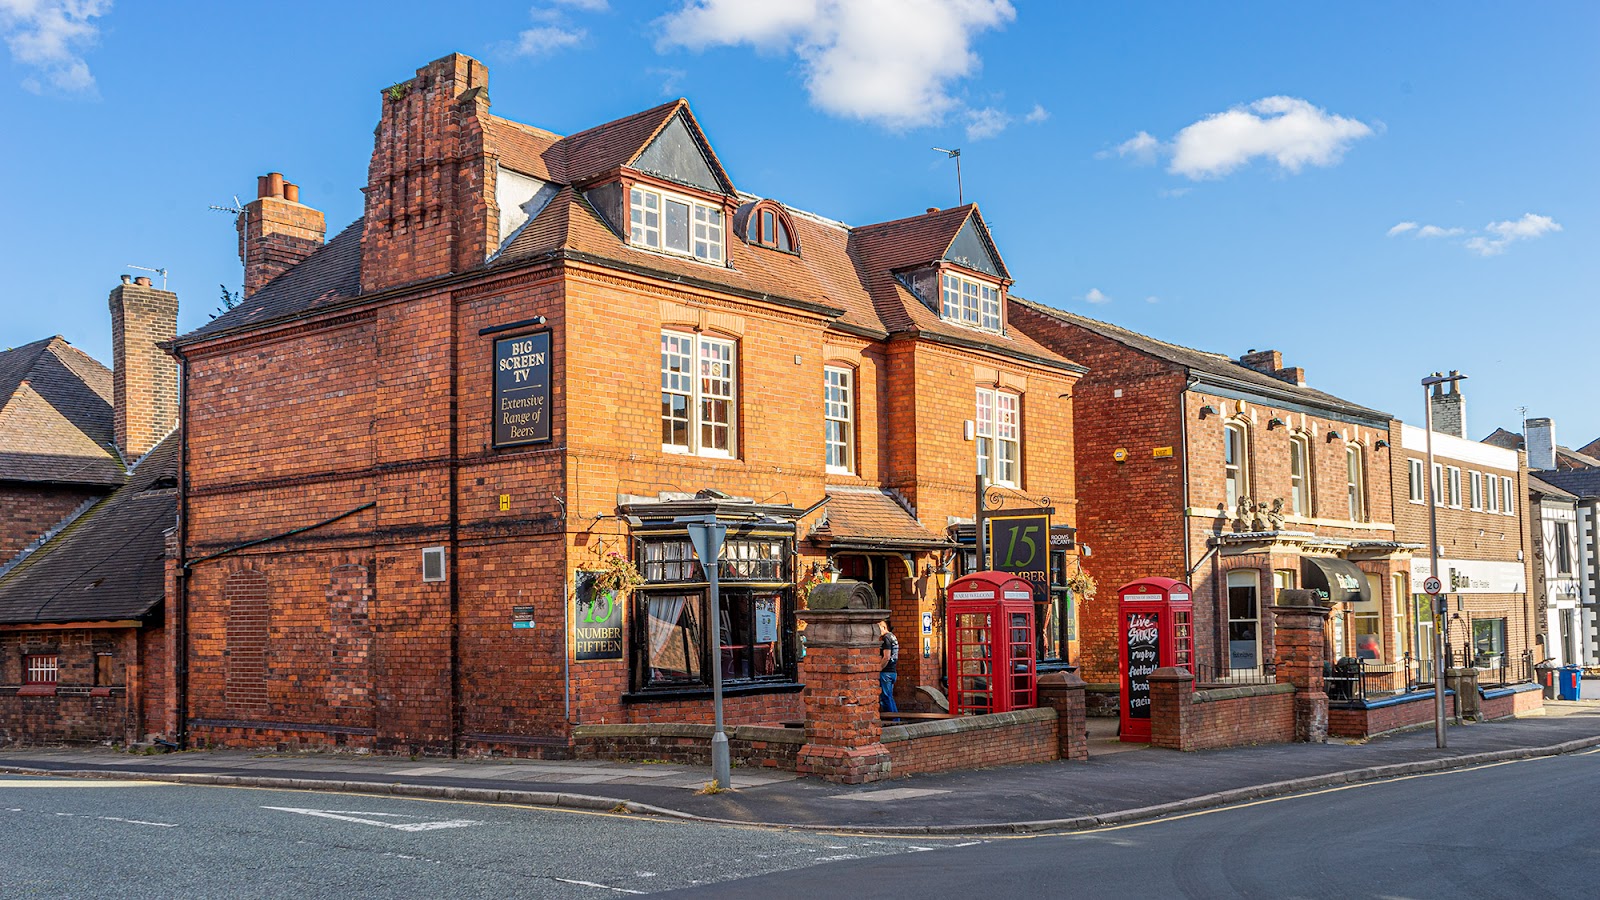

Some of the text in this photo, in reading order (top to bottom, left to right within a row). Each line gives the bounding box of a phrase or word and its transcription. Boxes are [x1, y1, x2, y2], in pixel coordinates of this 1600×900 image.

[511, 340, 533, 356] BIG
[499, 352, 545, 371] SCREEN
[513, 368, 531, 383] TV
[501, 395, 544, 410] Extensive
[503, 408, 542, 425] Range of
[510, 425, 534, 438] Beers
[501, 496, 509, 509] H
[1001, 526, 1039, 568] 15
[1426, 581, 1440, 590] 20
[1130, 614, 1153, 628] Live
[576, 628, 621, 639] NUMBER
[577, 641, 621, 653] FIFTEEN
[1131, 649, 1156, 661] rugby
